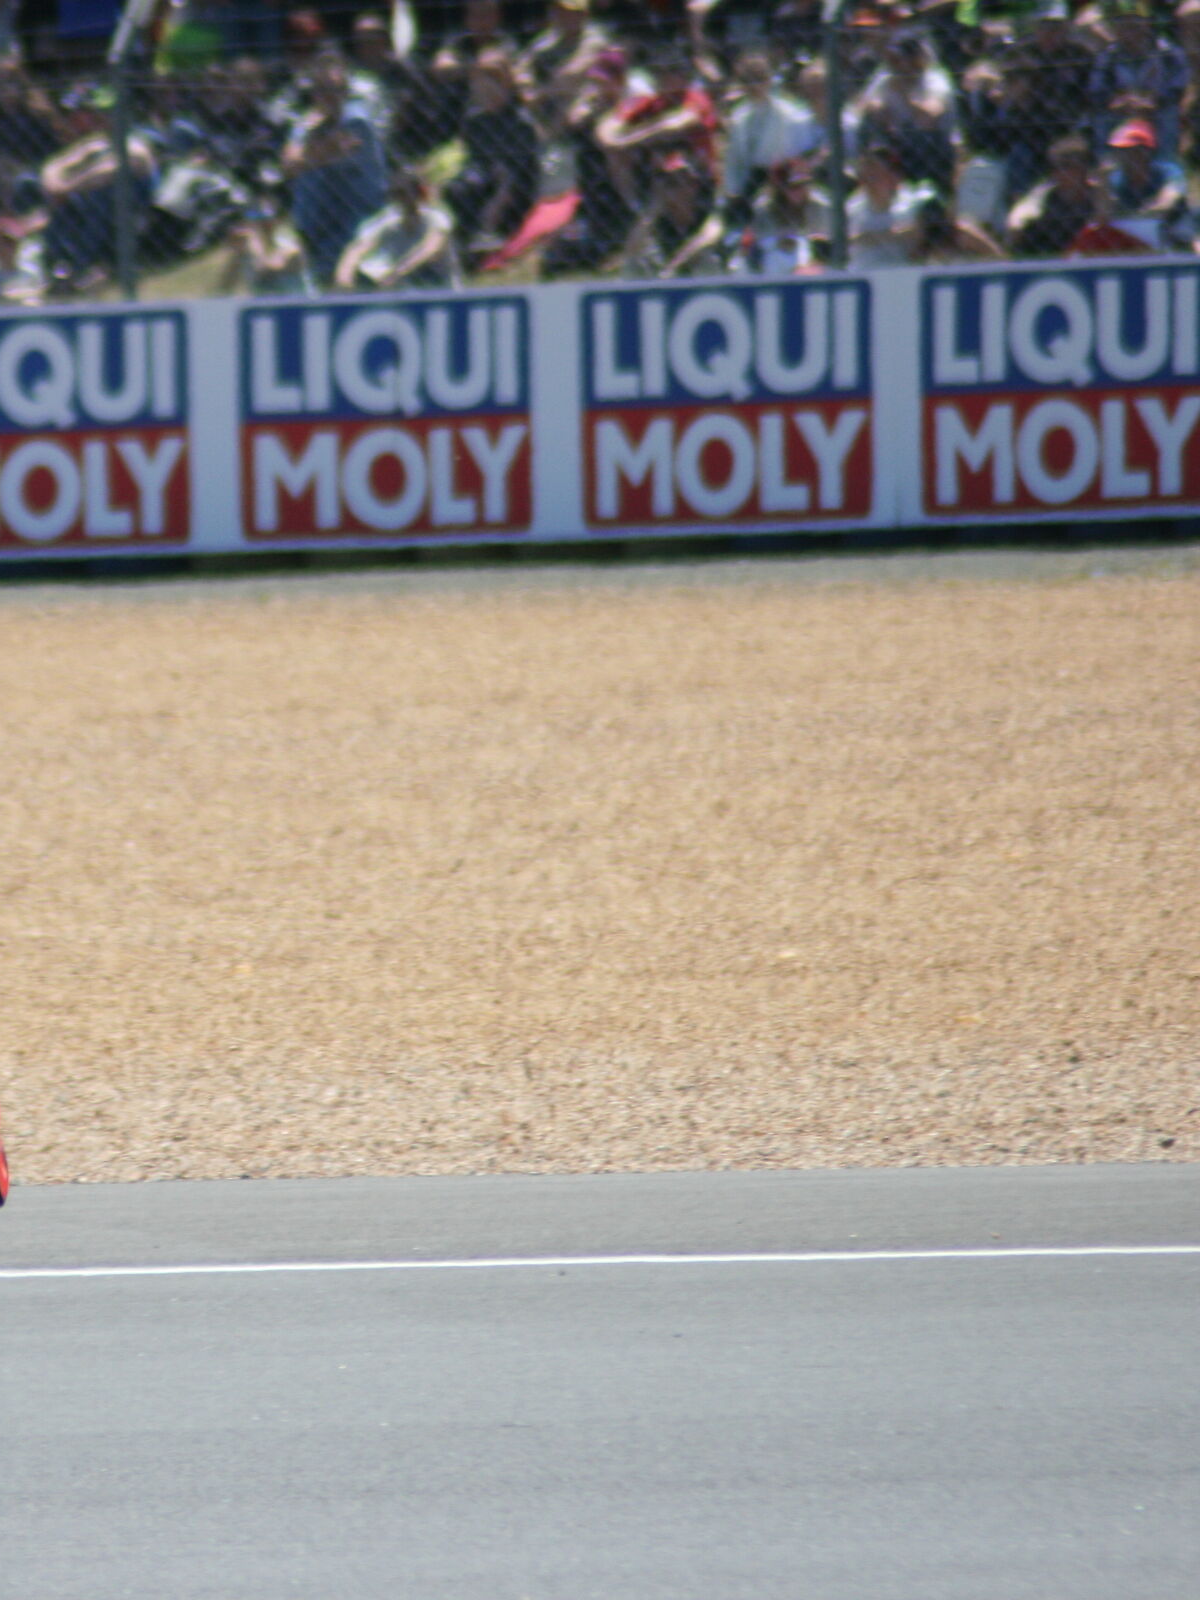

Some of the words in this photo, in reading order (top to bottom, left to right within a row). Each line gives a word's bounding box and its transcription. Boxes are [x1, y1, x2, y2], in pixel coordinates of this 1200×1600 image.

[250, 306, 520, 417] LIQUI
[591, 289, 860, 401] LIQUI
[931, 276, 1200, 388] LIQUI
[253, 424, 528, 532] MOLY
[594, 408, 868, 518] MOLY
[934, 397, 1200, 506] MOLY
